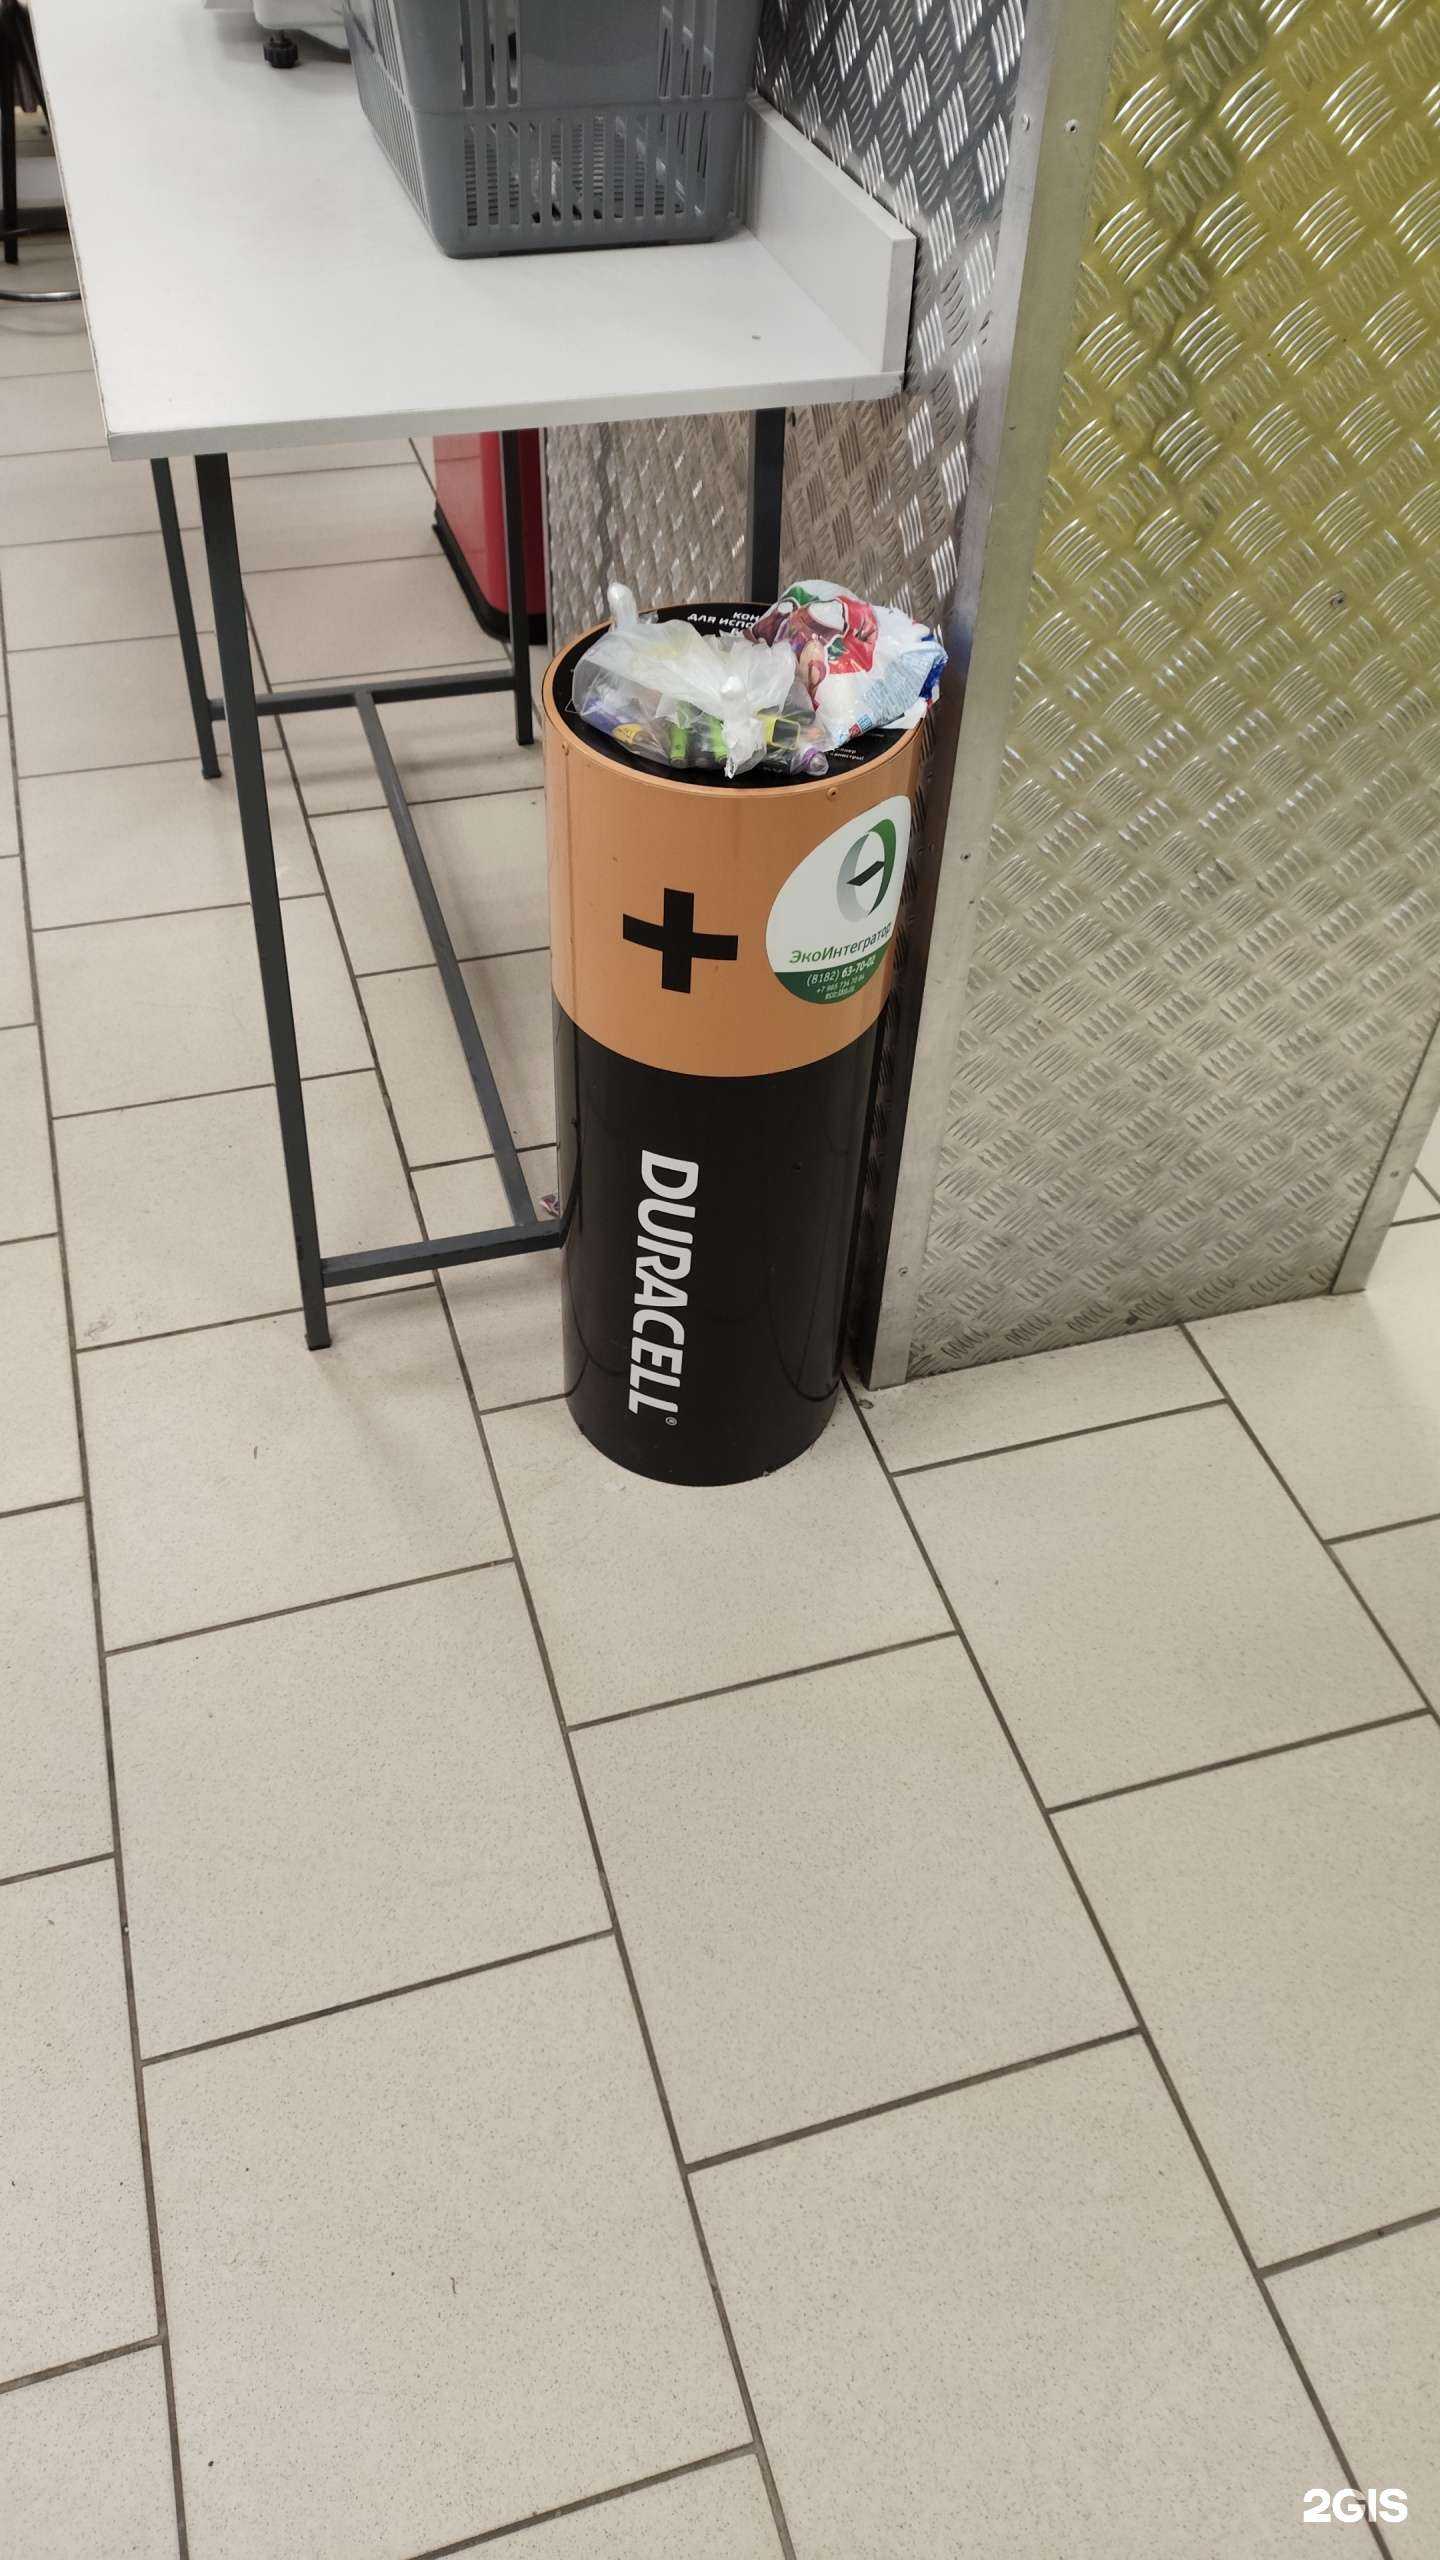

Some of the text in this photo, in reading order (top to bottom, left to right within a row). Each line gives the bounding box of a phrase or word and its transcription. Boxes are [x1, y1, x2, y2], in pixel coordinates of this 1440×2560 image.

[687, 613, 717, 623] ДЛЯ
[789, 922, 893, 964] ЭкоИнтегратор
[628, 1149, 699, 1415] DURACELL
